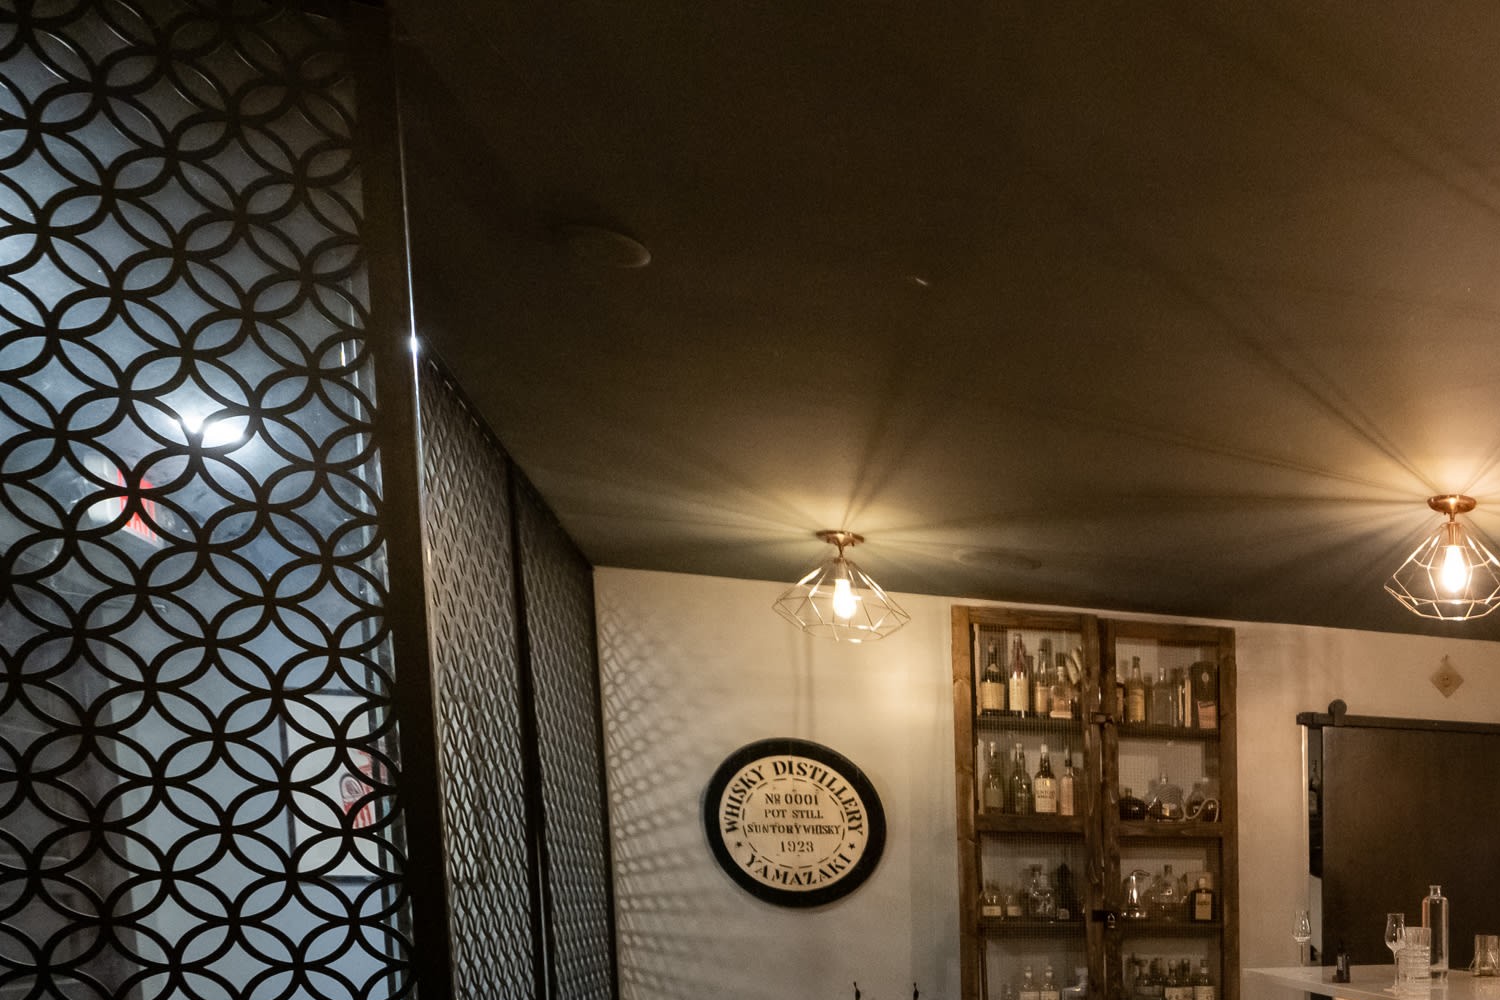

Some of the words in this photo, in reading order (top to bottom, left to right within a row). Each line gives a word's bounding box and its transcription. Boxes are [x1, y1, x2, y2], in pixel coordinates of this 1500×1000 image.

[723, 765, 766, 834] WHISKY
[771, 760, 864, 836] DISTILLERY
[784, 793, 820, 805] 0001
[764, 809, 788, 819] POT
[791, 809, 824, 819] STILL
[747, 823, 803, 834] SUNTORY
[803, 824, 841, 835] WHISKY
[780, 841, 814, 853] 1923
[745, 853, 852, 886] YAMAZAKI
